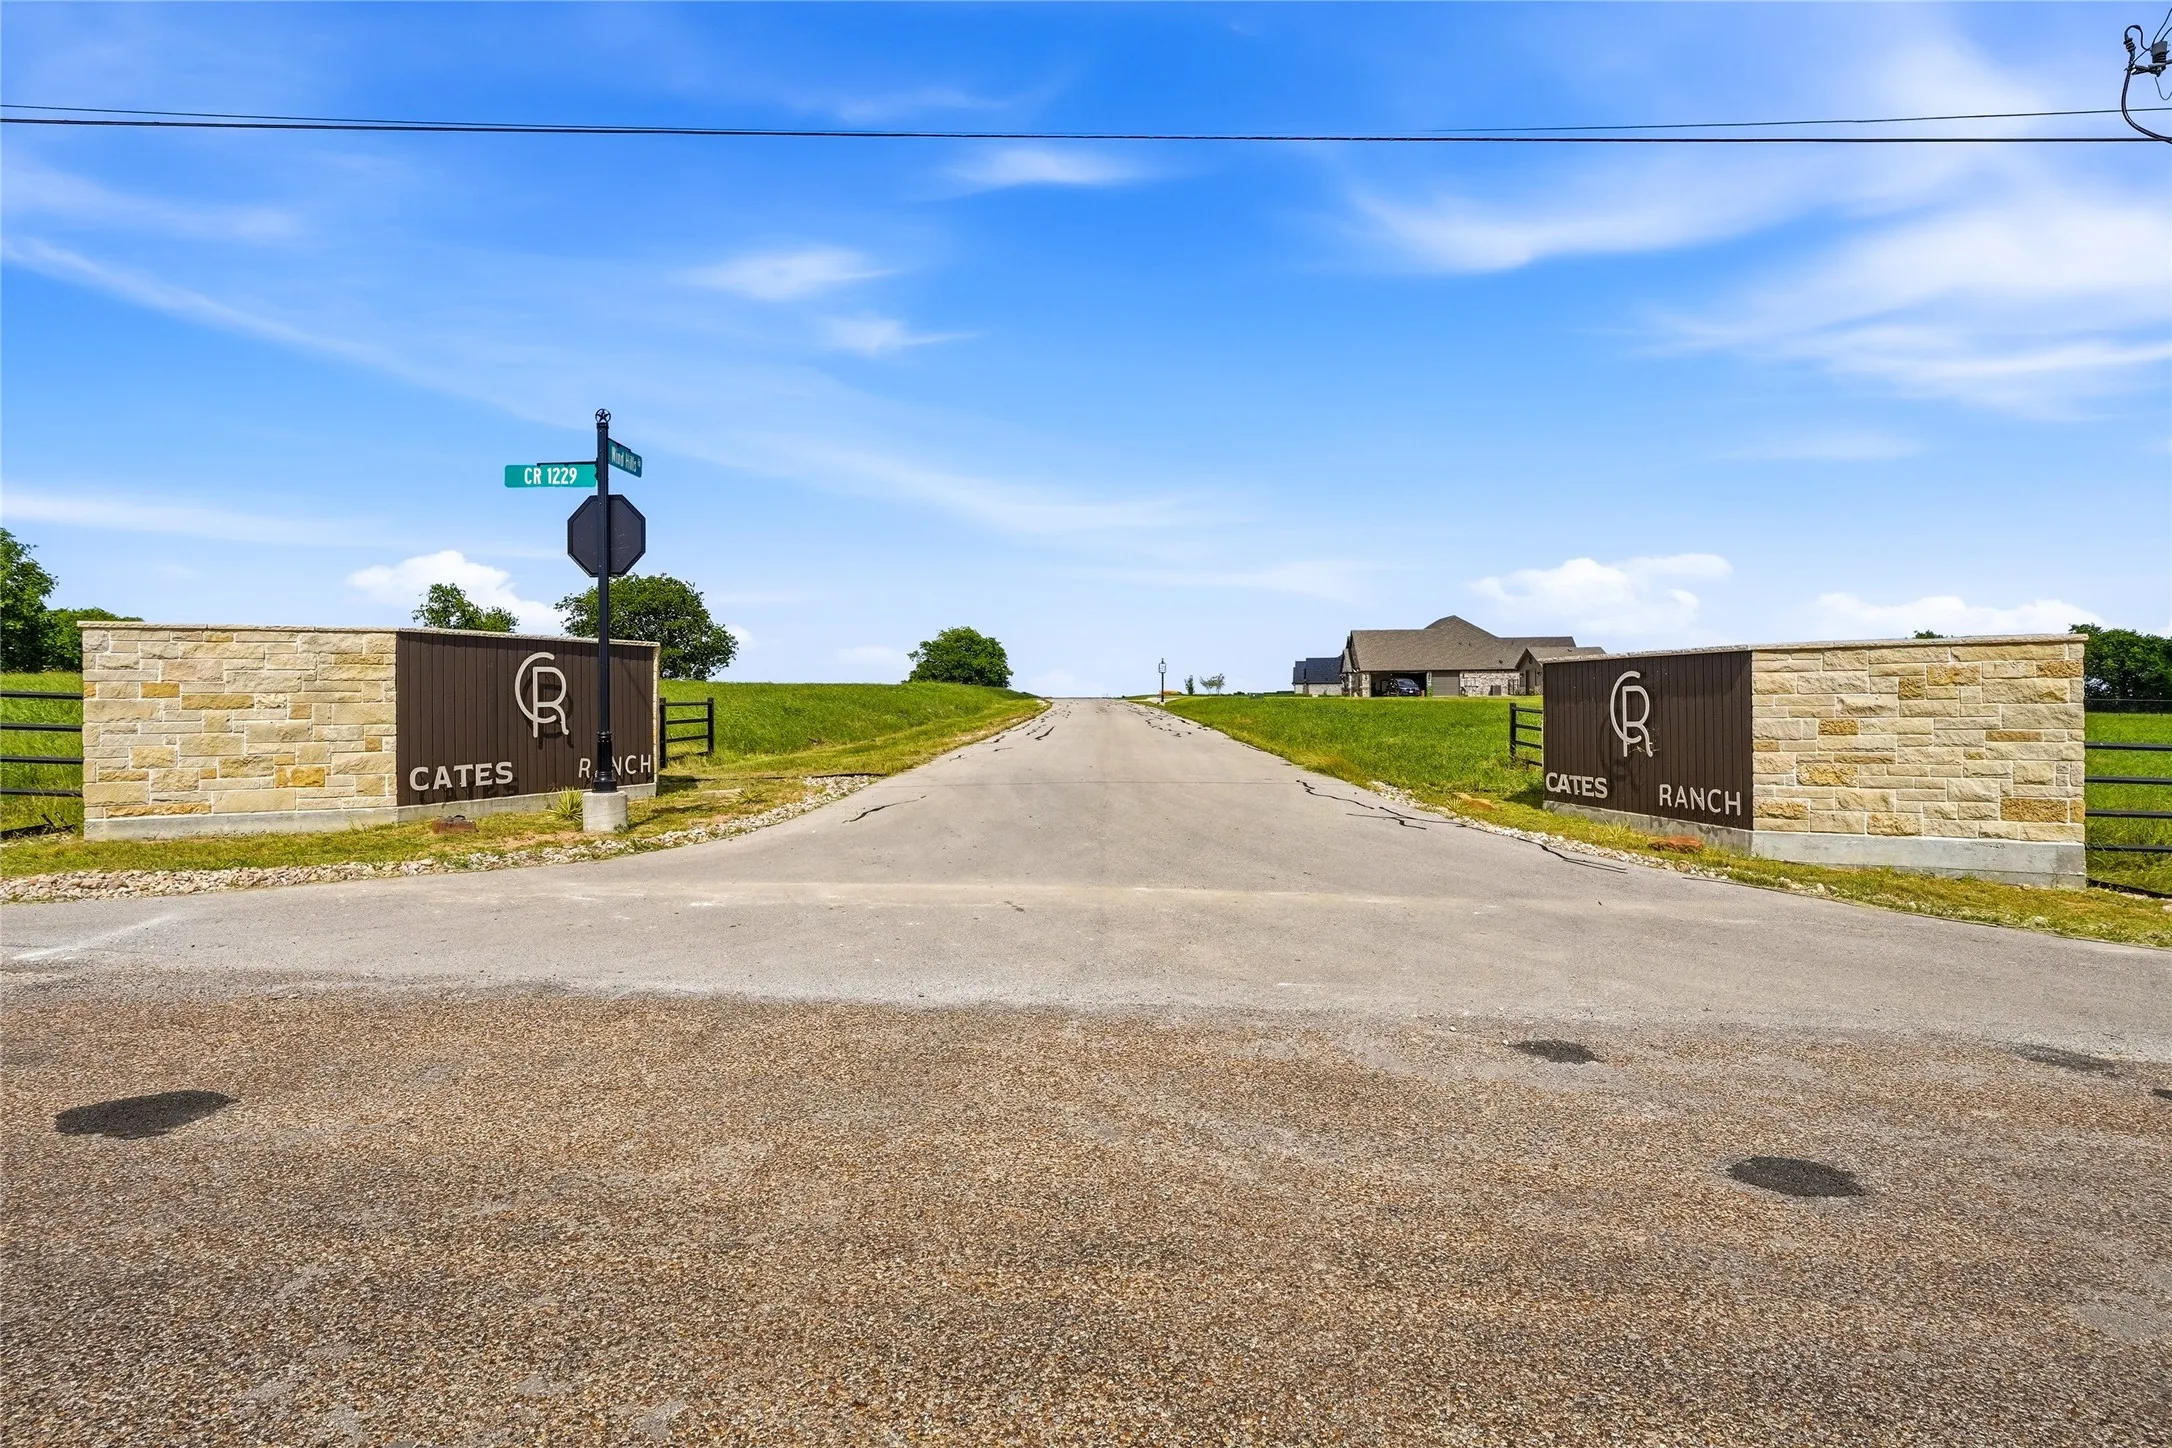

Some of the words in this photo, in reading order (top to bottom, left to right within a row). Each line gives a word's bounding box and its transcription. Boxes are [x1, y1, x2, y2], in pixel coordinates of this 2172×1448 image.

[524, 467, 542, 485] CR
[547, 467, 578, 485] 1229
[409, 761, 514, 792] CATES
[578, 754, 652, 779] RNCH
[1545, 772, 1608, 799] CATES
[1659, 784, 1741, 816] RANCH
